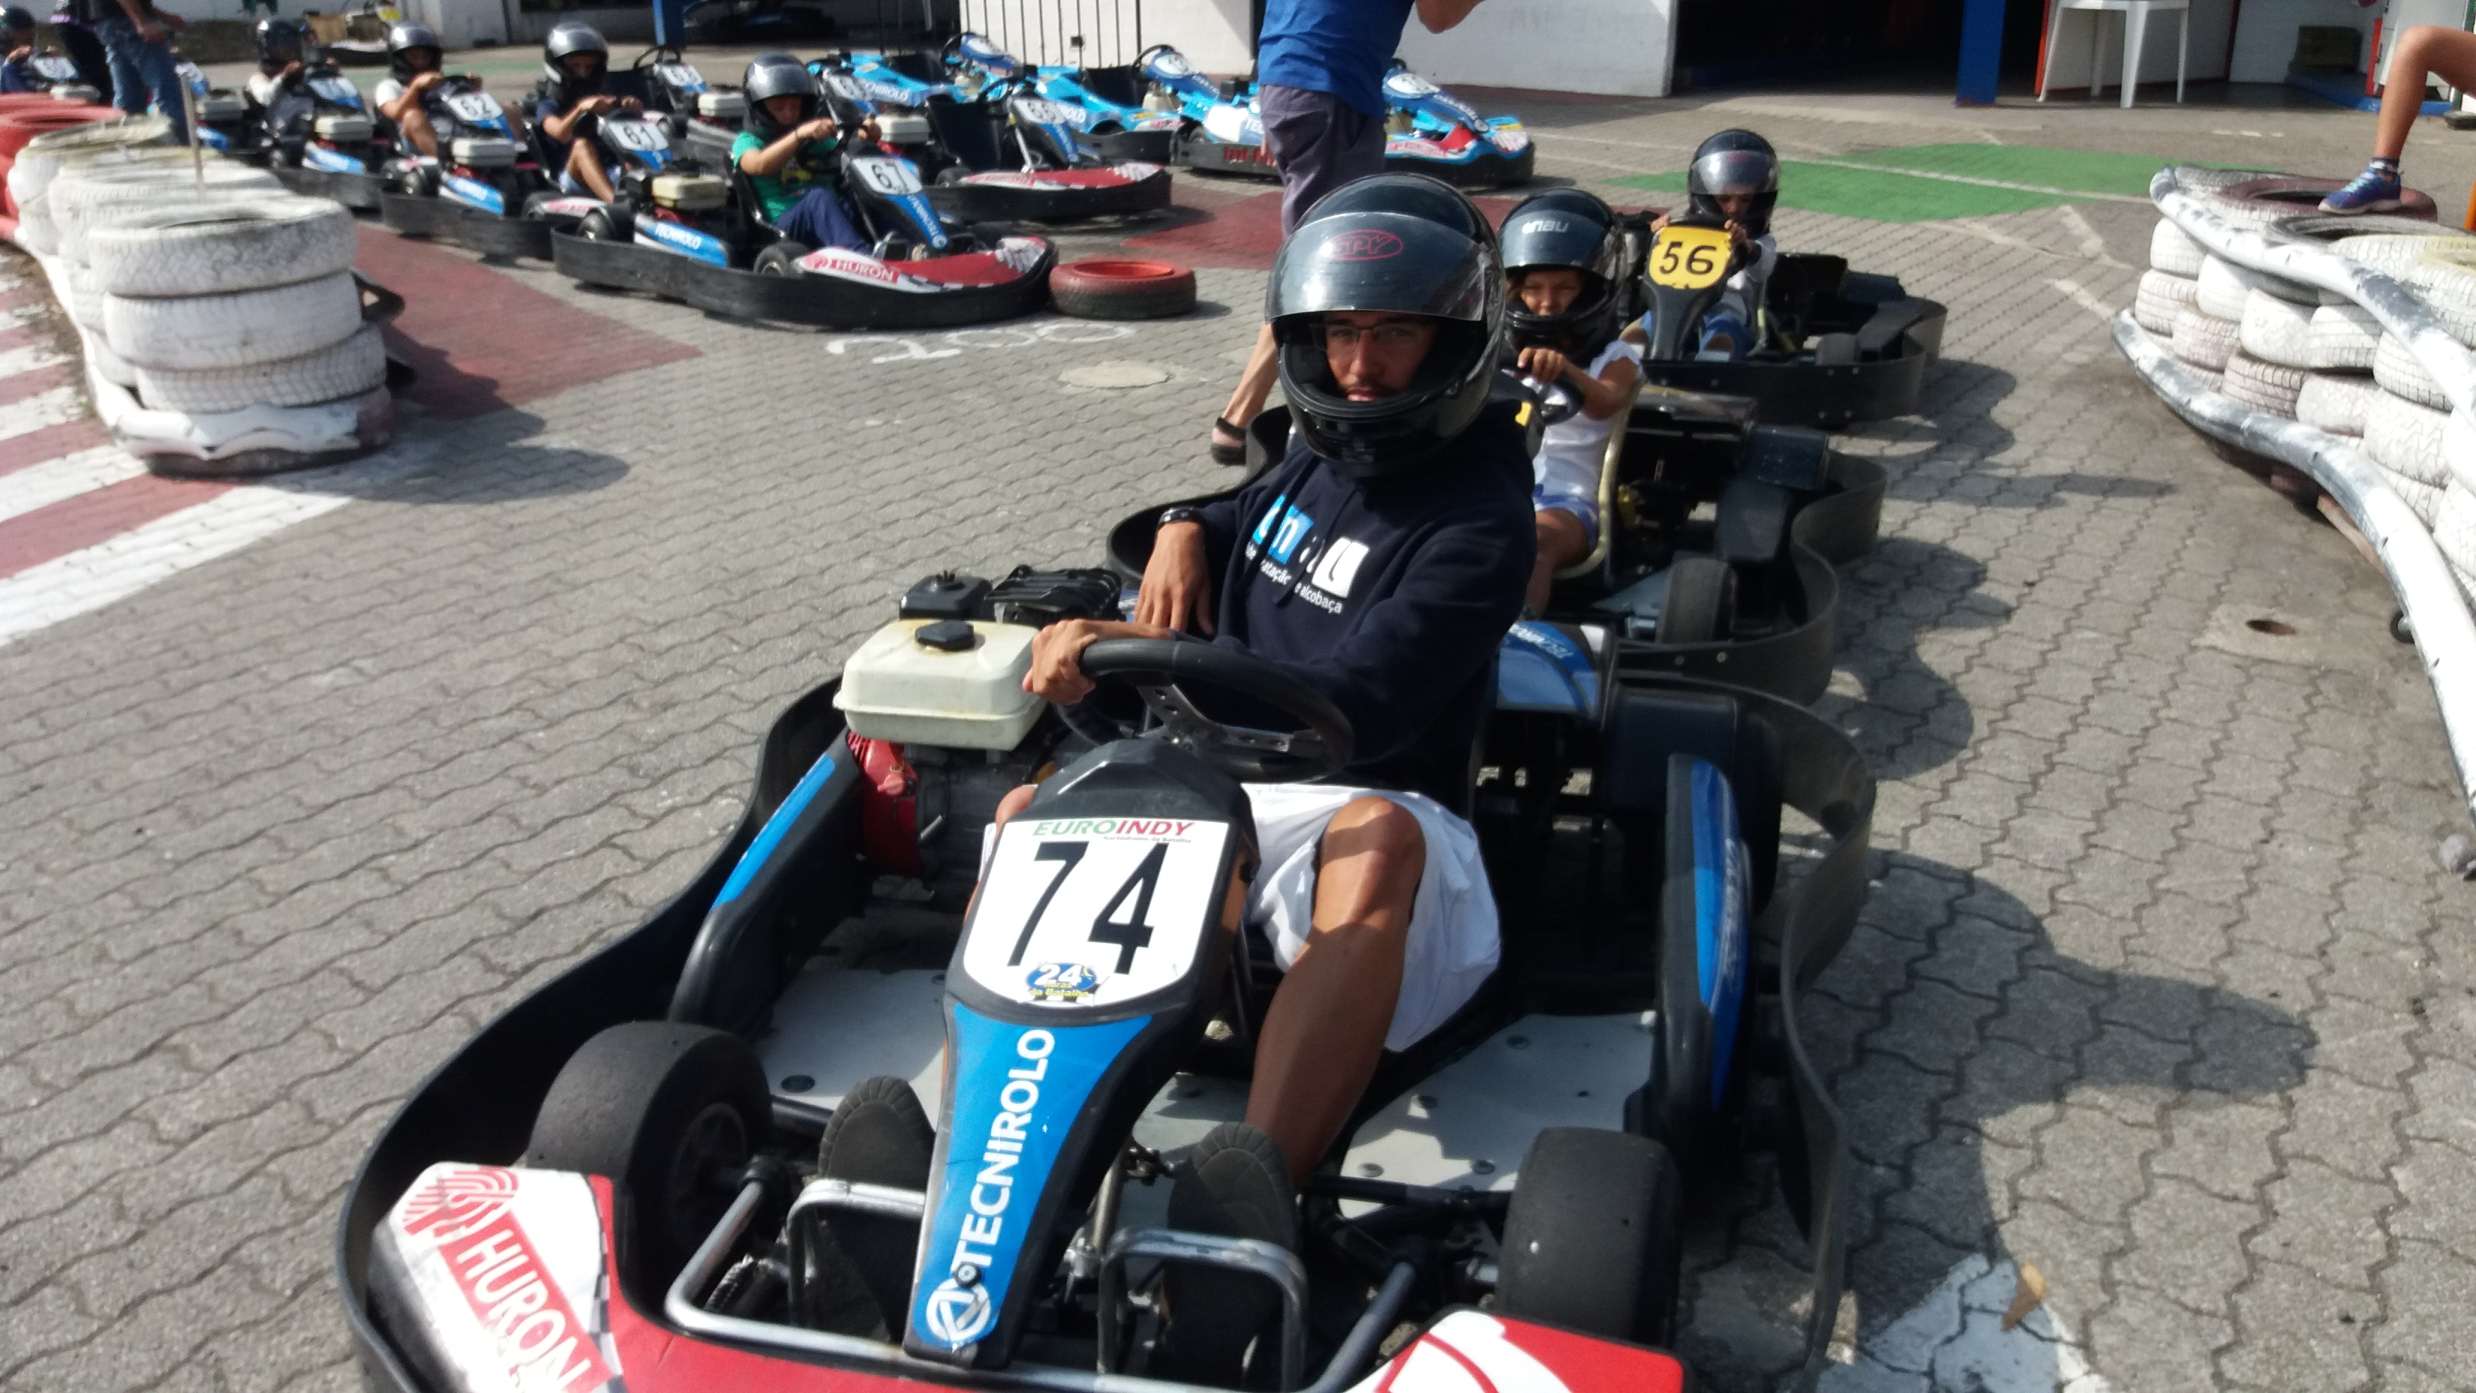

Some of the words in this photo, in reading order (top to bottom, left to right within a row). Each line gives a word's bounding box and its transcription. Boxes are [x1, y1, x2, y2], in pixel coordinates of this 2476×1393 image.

[622, 125, 657, 149] 61
[871, 160, 909, 192] 67
[835, 258, 895, 282] HURON
[1659, 241, 1717, 275] 56
[1033, 818, 1196, 837] EUROINDY
[1007, 841, 1169, 975] 74
[1034, 963, 1082, 987] 24
[951, 1029, 1056, 1274] TECNIROLO
[456, 1228, 592, 1392] HURON
